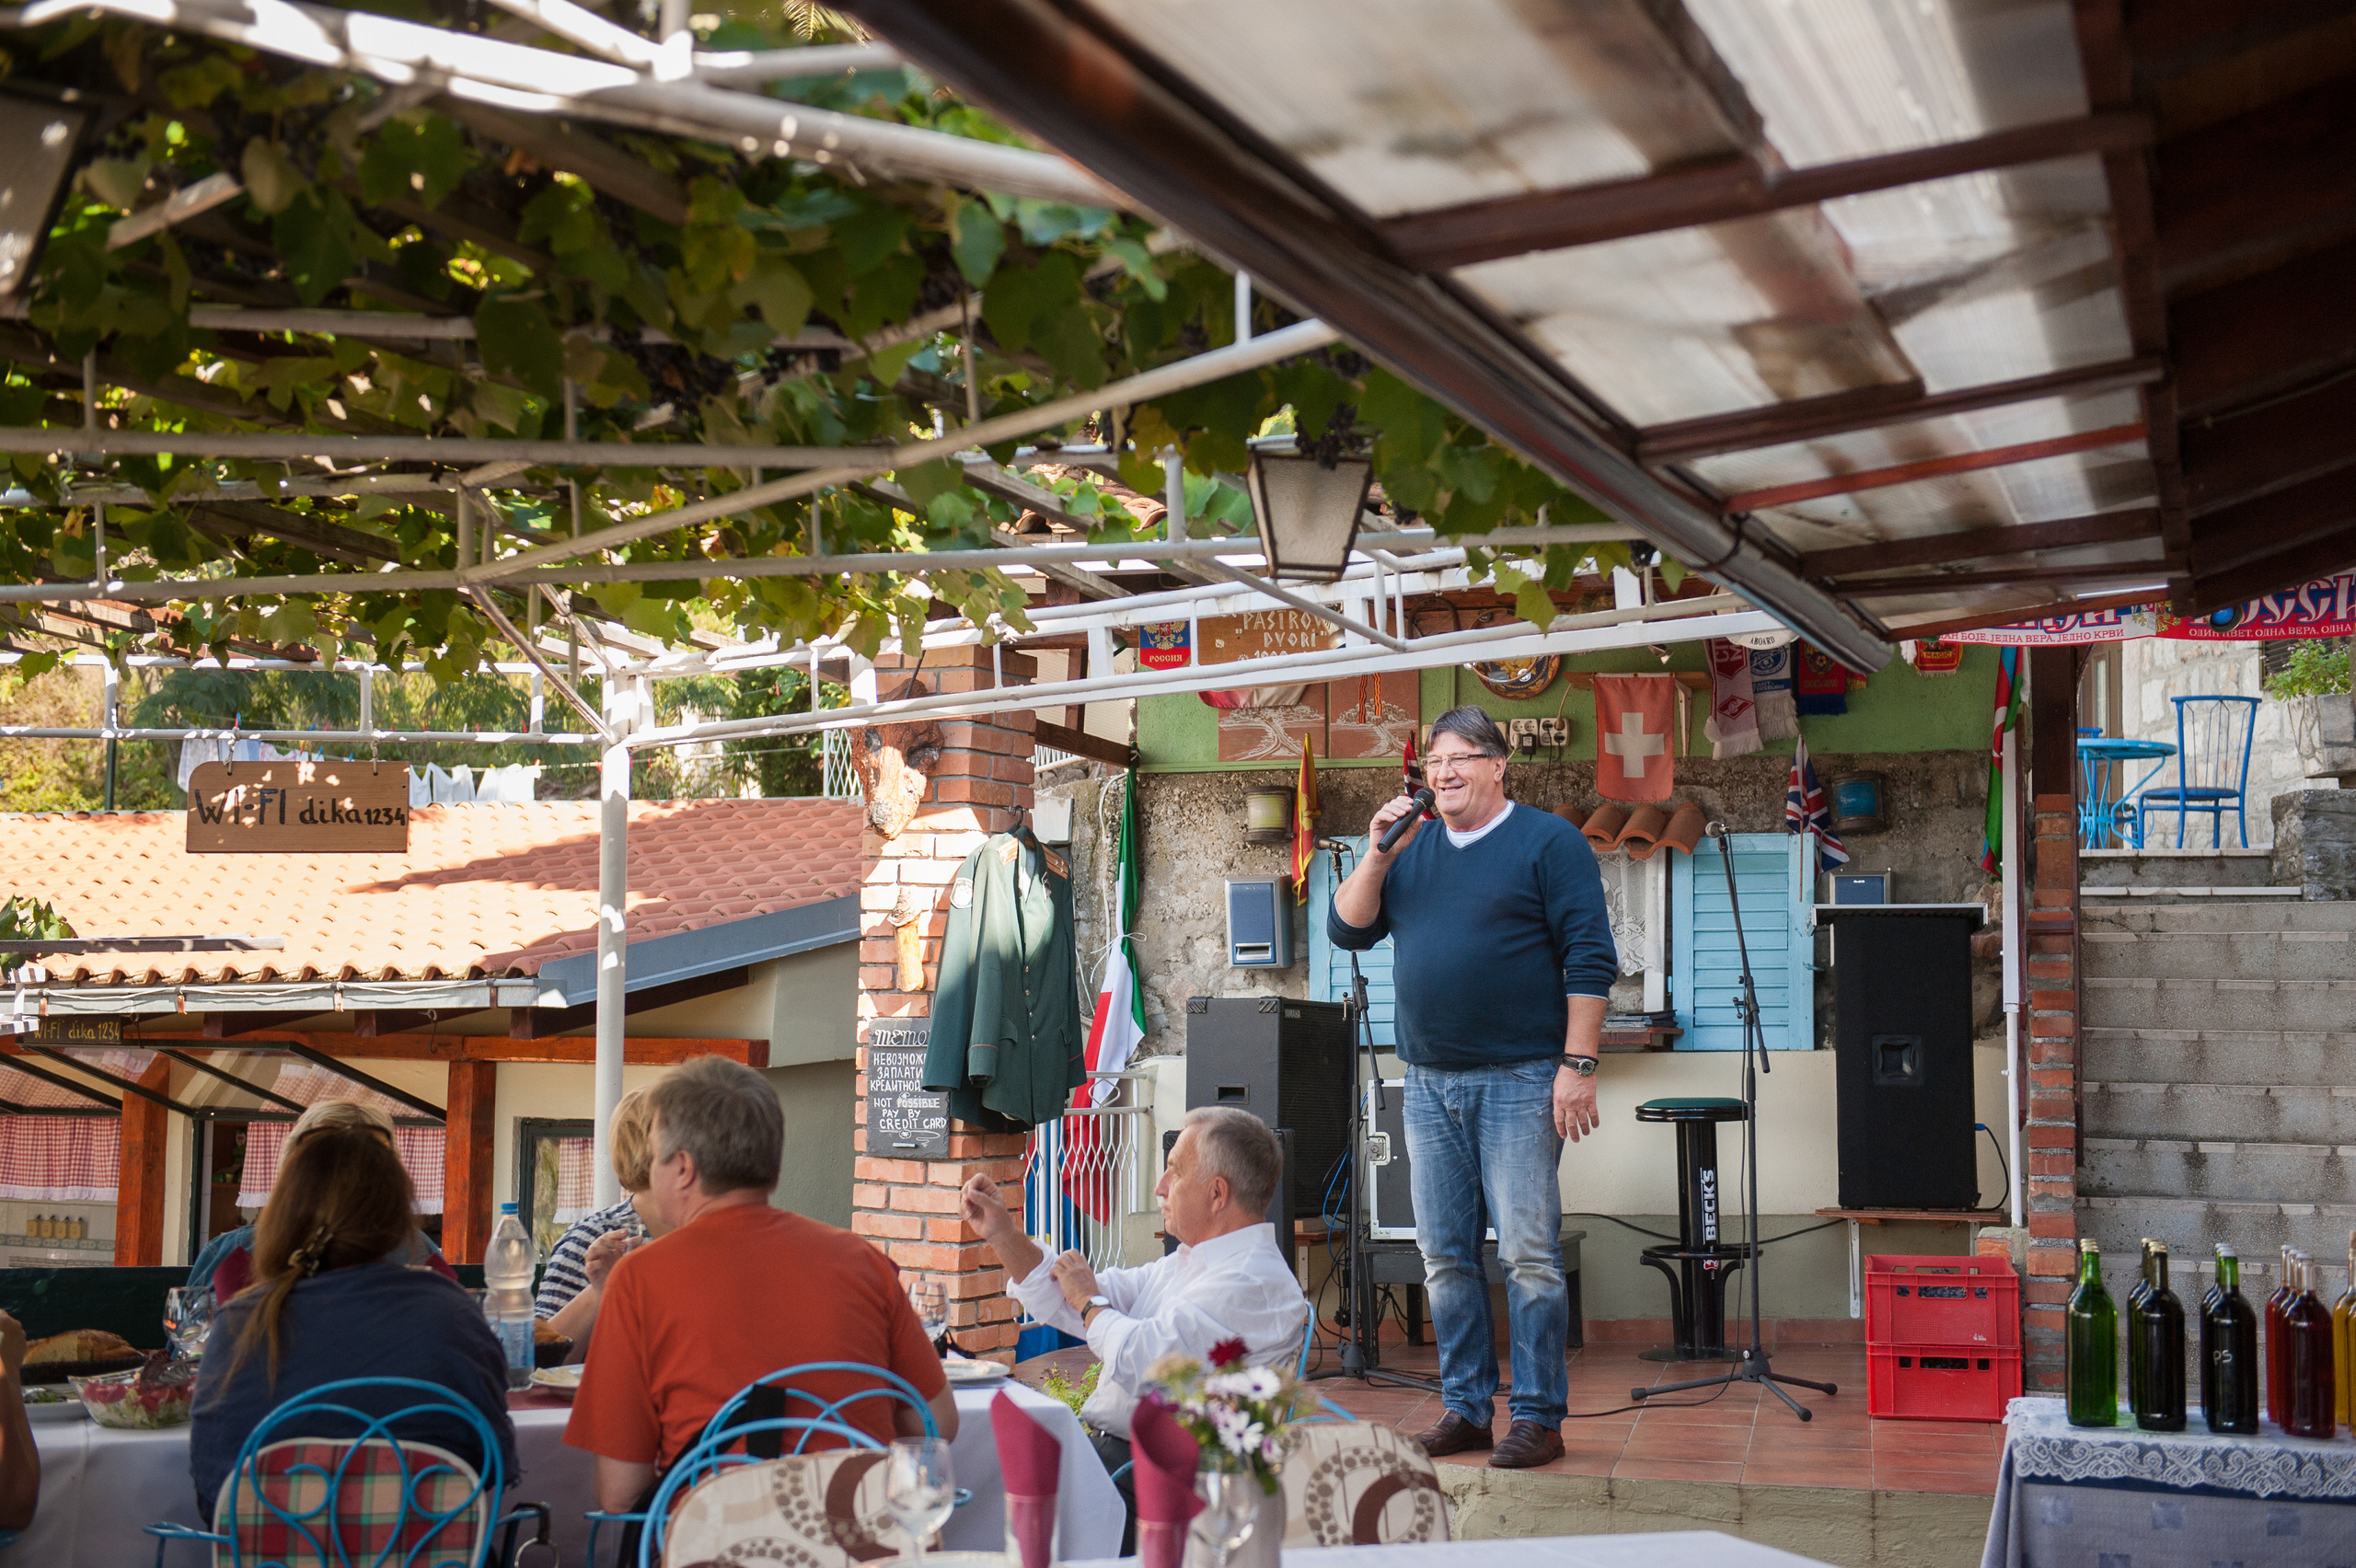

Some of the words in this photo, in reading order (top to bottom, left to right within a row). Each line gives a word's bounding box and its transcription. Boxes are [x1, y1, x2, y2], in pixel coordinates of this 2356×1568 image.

[2094, 628, 2124, 640] КРВИ
[2255, 628, 2285, 637] ОДНА
[2321, 623, 2351, 634] ОДНА
[1750, 636, 1775, 646] ABOARD
[1149, 654, 1183, 663] РОССИЯ
[877, 1066, 923, 1079] ЗАПЛАТИ
[896, 1097, 941, 1108] POSSIBLE
[882, 1109, 899, 1118] PAY
[907, 1109, 921, 1119] BY
[879, 1118, 918, 1130] CREDIT
[922, 1117, 947, 1129] CARD
[1701, 1170, 1716, 1240] BECK'S
